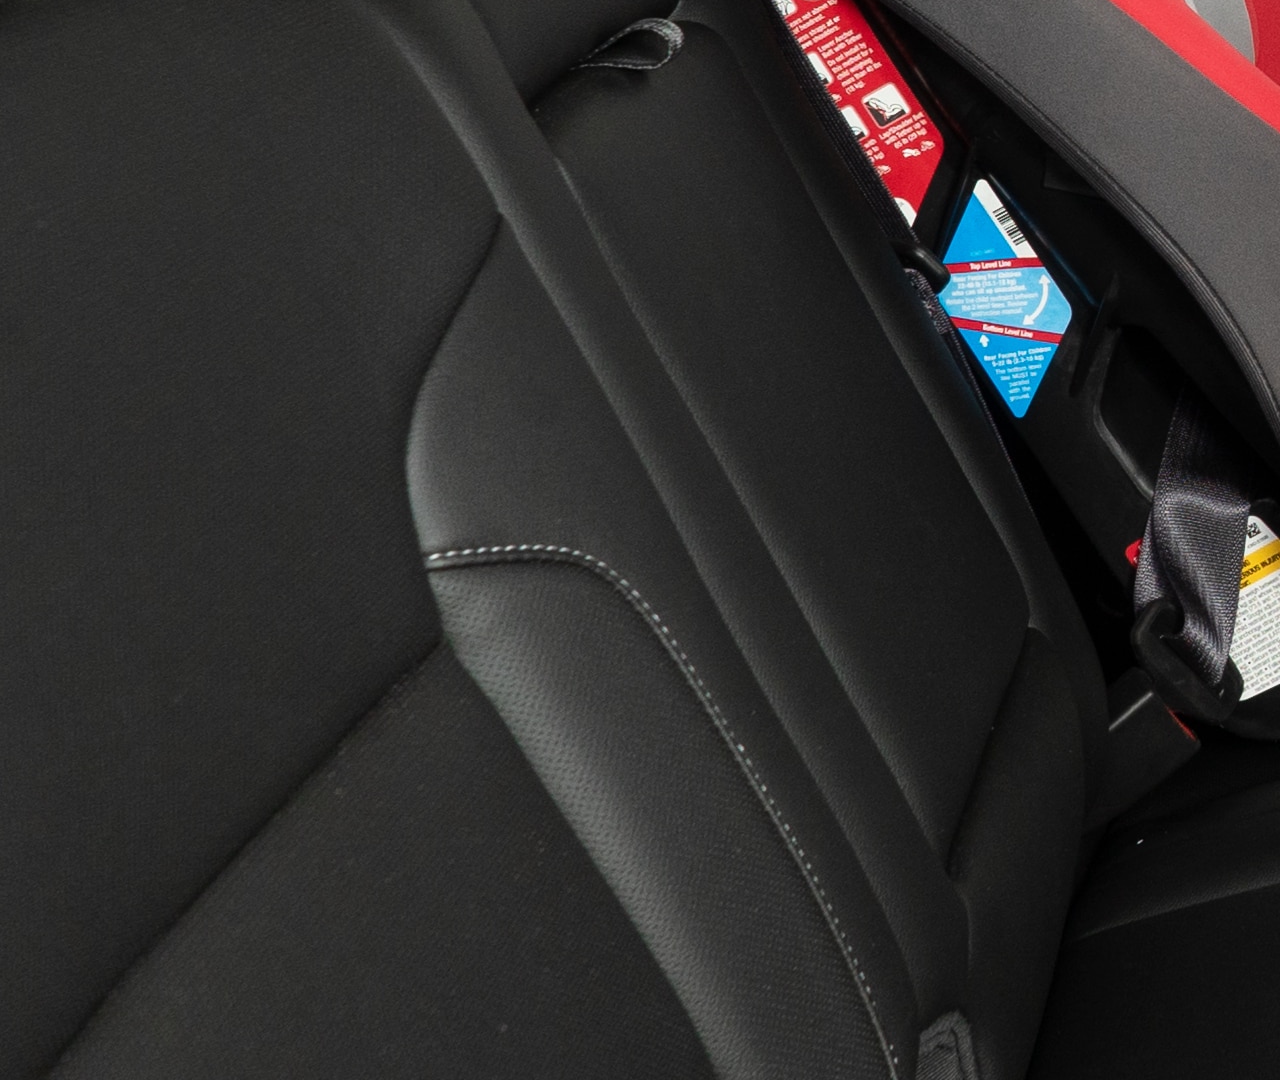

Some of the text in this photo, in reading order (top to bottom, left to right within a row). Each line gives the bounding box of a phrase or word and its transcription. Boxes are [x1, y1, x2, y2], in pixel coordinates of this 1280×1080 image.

[970, 263, 980, 271] Top
[1005, 327, 1020, 336] Level
[1021, 330, 1033, 339] Line
